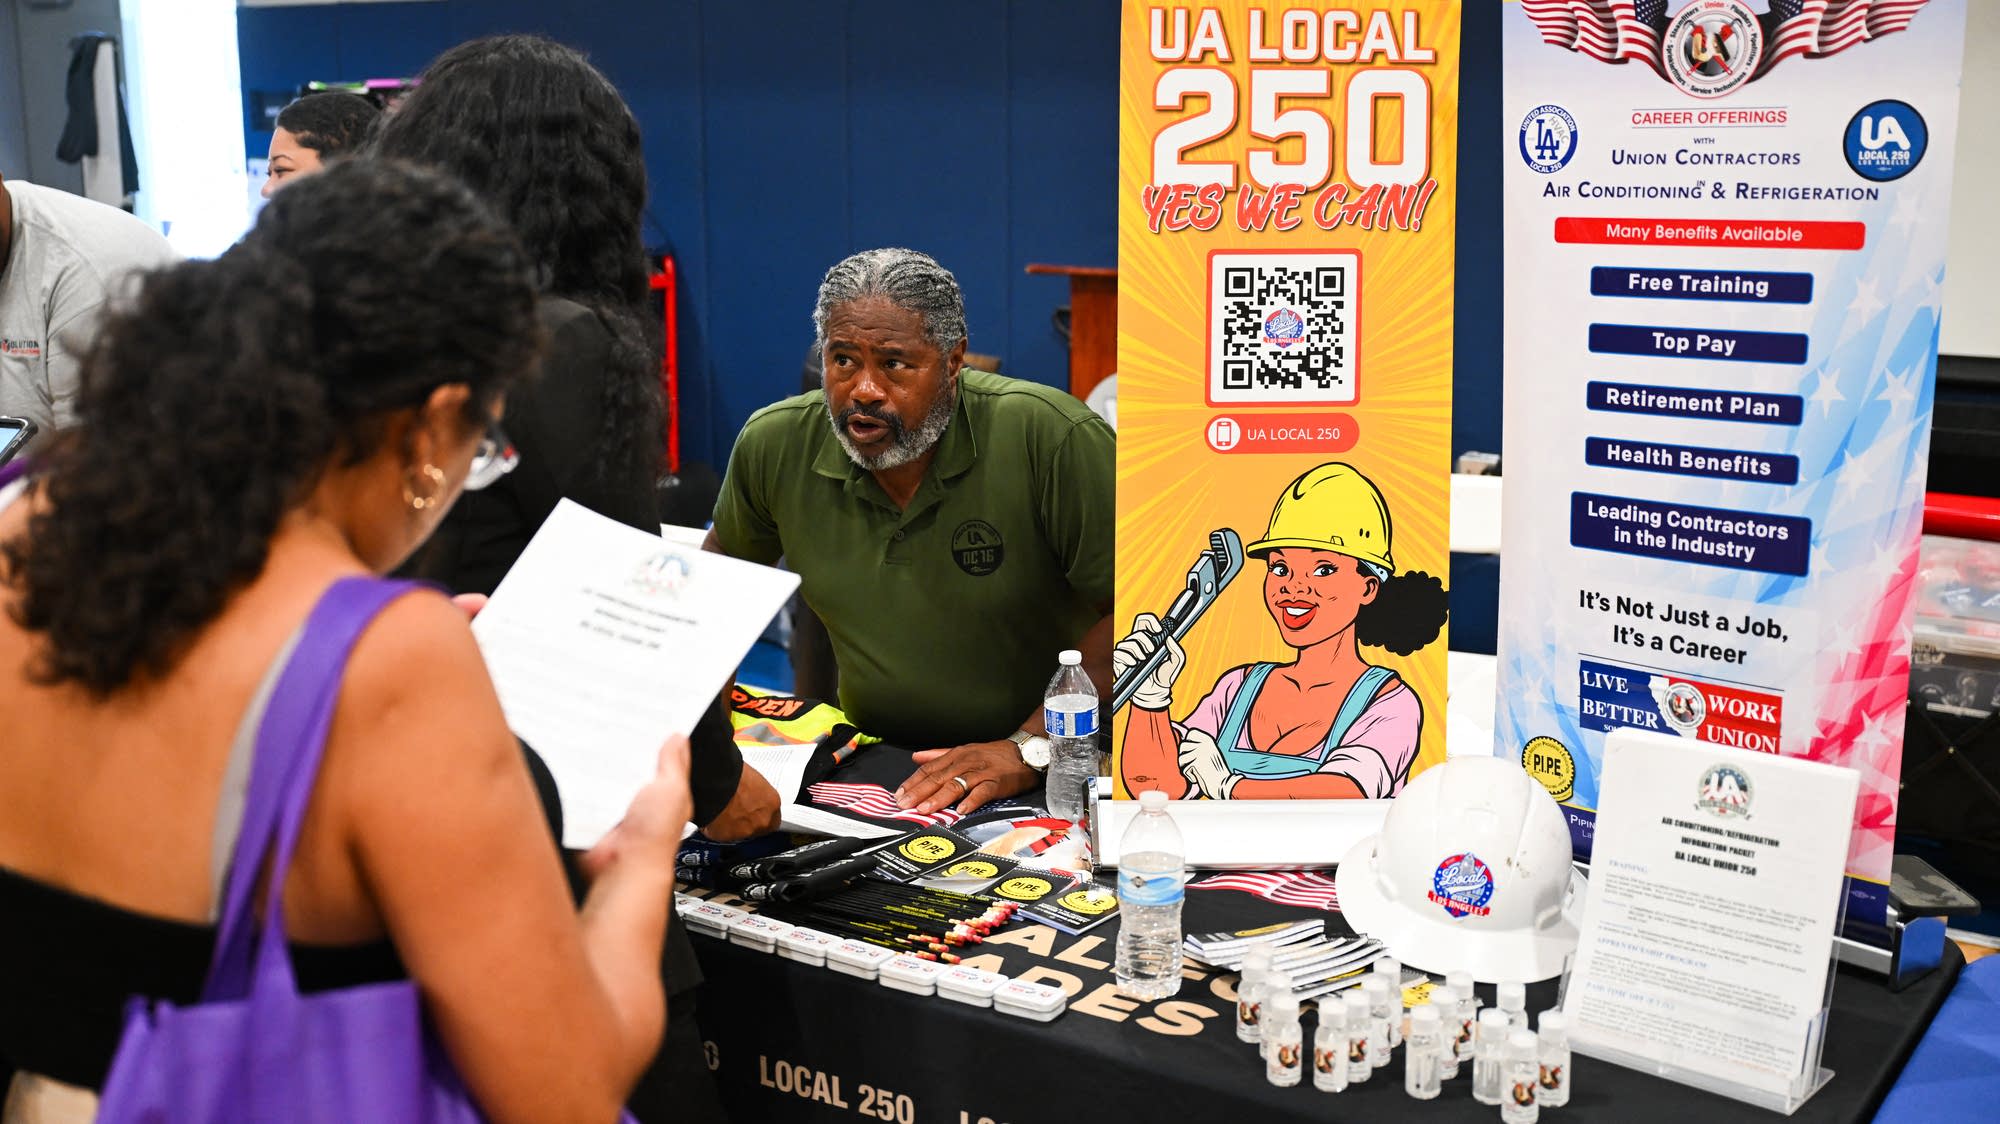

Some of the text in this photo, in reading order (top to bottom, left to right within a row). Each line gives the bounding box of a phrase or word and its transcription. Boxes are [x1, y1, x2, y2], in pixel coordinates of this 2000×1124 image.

[1150, 7, 1436, 64] UA LOCAL
[1151, 66, 1430, 191] 250
[1522, 106, 1576, 132] UNITED ASSOCIATION
[1632, 110, 1787, 125] CAREER OFFERINGS
[1535, 119, 1559, 160] LA
[1693, 137, 1715, 145] WITH
[1860, 115, 1911, 150] UA
[1530, 161, 1562, 173] LOCAL 250
[1612, 149, 1801, 165] UNION CONTRACTORS
[1858, 150, 1910, 160] LOCAL 250
[1142, 179, 1438, 232] YES WE CAN!
[1543, 181, 1879, 201] AIR CONDITIONING & REFRIGERATION
[1606, 224, 1803, 241] Many Benefits Available
[1628, 273, 1769, 297] Free Training
[1652, 332, 1736, 356] Top Pay
[1606, 388, 1780, 417] Retirement Plan
[1247, 428, 1340, 441] UA LOCAL 250
[1607, 444, 1771, 476] Health Benefits
[1588, 501, 1789, 540] Leading Contractors
[1614, 526, 1755, 562] in the Industry
[1616, 596, 1653, 619] Not
[1660, 604, 1710, 629] Just
[1716, 617, 1729, 631] a
[1736, 616, 1788, 643] Job,
[1651, 636, 1663, 651] a
[1670, 635, 1747, 665] Career
[1582, 670, 1629, 694] LIVE
[1583, 698, 1660, 730] BETTER
[1707, 694, 1778, 723] WORK
[1707, 725, 1777, 754] UNION
[1533, 753, 1563, 777] P.I.P.E.
[1439, 865, 1488, 887] Local
[759, 1055, 849, 1109] LOCAL
[858, 1084, 915, 1124] 250
